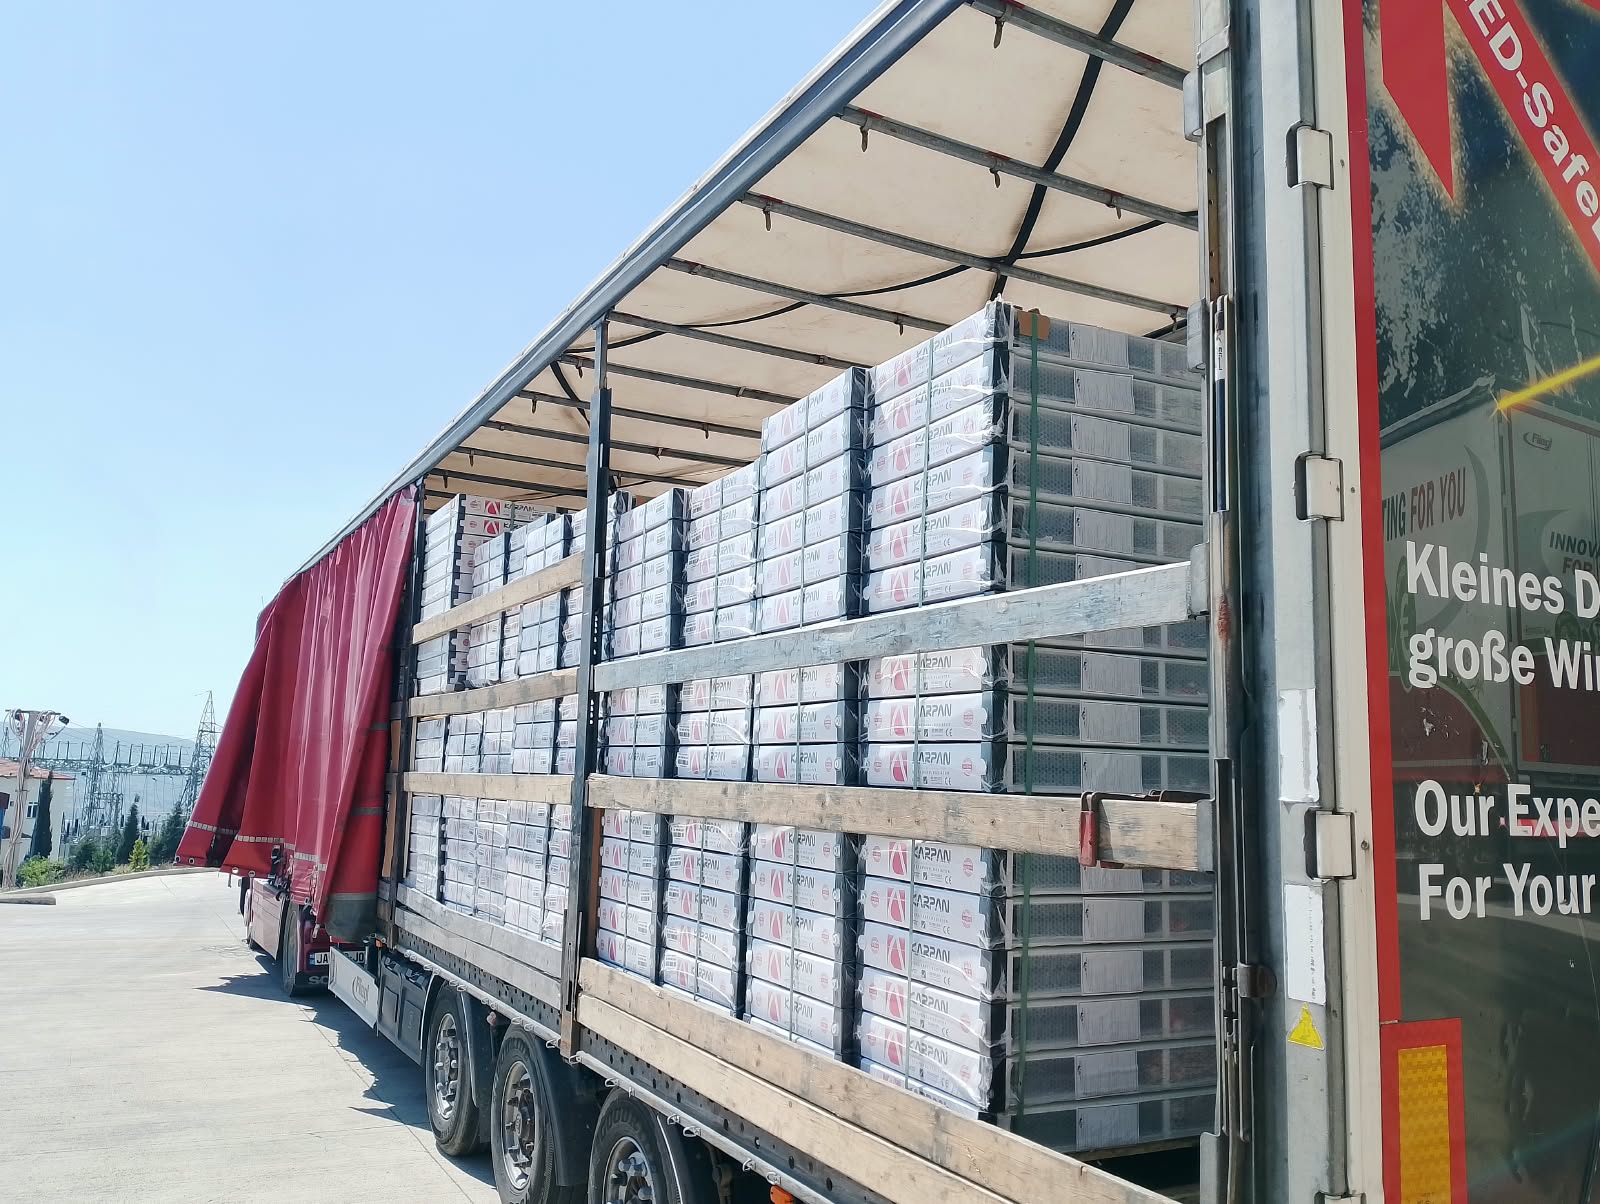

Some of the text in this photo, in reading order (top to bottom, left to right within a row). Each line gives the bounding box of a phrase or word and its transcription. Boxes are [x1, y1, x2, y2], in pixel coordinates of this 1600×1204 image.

[1464, 0, 1600, 244] ED-Safe
[916, 332, 953, 363] KAPAN
[798, 391, 824, 414] KAPAN
[796, 431, 823, 451] KAPAN
[1410, 480, 1435, 533] FOR
[1440, 466, 1466, 523] YOU
[794, 509, 822, 529] KAPAN
[793, 550, 820, 567] KAPAN
[913, 561, 951, 582] KRPAN
[1406, 540, 1564, 614] Kleines
[792, 589, 820, 606] KAPAN
[1409, 628, 1535, 688] große
[790, 669, 818, 683] KAPAN
[913, 703, 952, 718] ARPAN
[913, 751, 951, 765] ARPAN
[1414, 779, 1600, 848] Our Expe
[788, 832, 816, 847] KRPAN
[696, 857, 720, 870] KRPAN
[787, 872, 815, 888] KRPAN
[694, 894, 718, 908] KRPAN
[1418, 862, 1595, 921] For Your
[786, 914, 814, 932] KRPAN
[784, 954, 813, 975] KRPAN
[784, 996, 813, 1018] KRPAN
